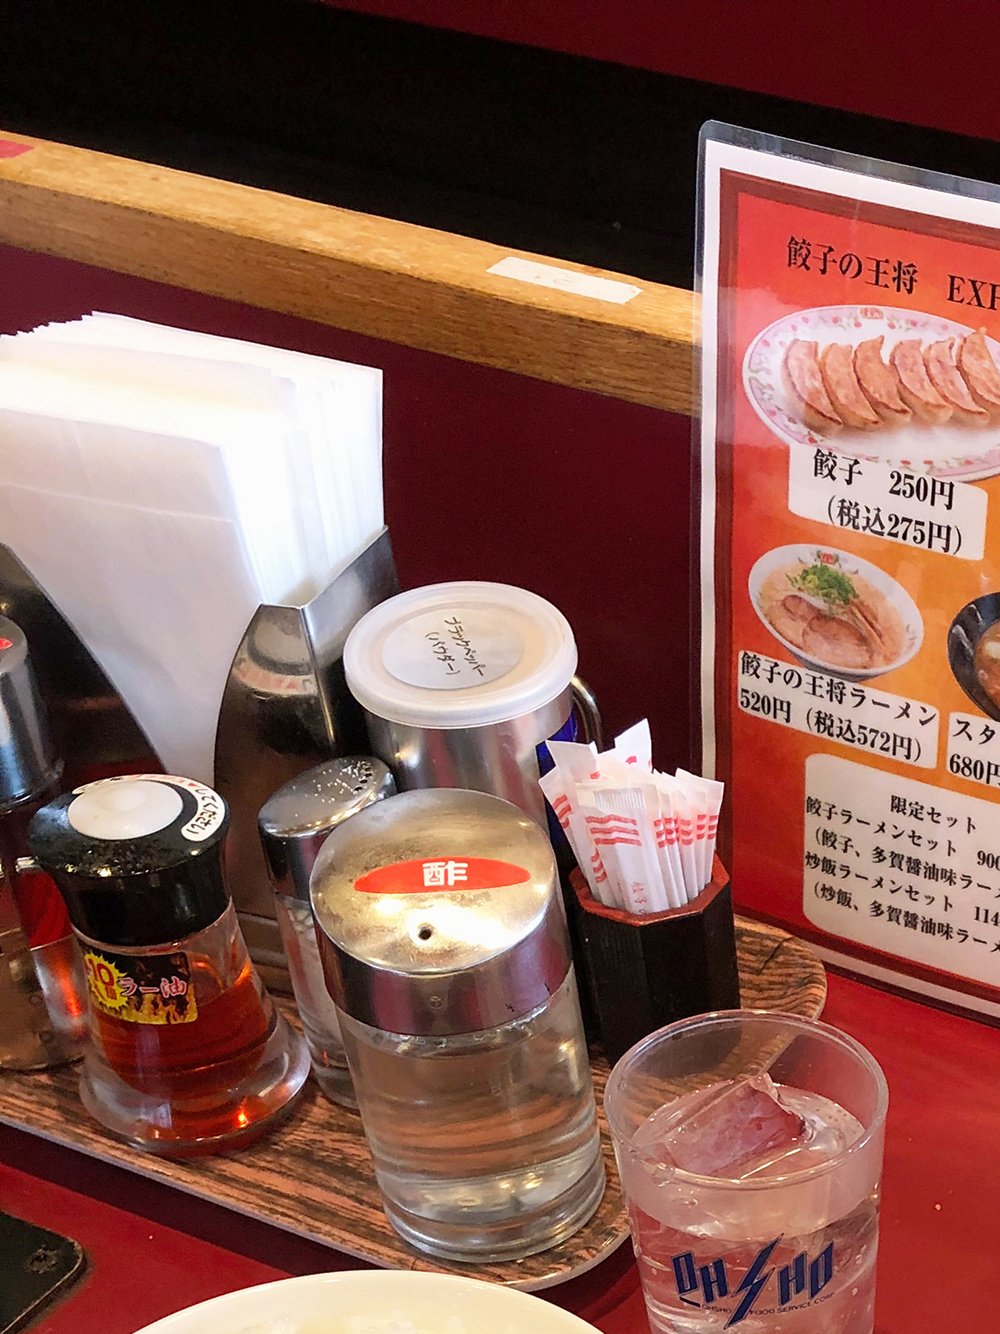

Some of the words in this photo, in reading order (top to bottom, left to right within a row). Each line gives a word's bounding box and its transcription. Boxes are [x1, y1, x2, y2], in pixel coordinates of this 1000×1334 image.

[787, 235, 918, 296] 餃子の王将
[814, 449, 862, 484] 餃子
[889, 471, 955, 510] 250円
[826, 494, 963, 554] （税込275円）
[741, 653, 937, 726] 餃子の王将ラーメン
[806, 796, 958, 857] 餃子ラーメンセット
[891, 796, 977, 833] 限定セット
[422, 860, 469, 888] 酢
[805, 852, 953, 912] 炒飯ラーメンセット
[117, 974, 189, 1000] ラー油
